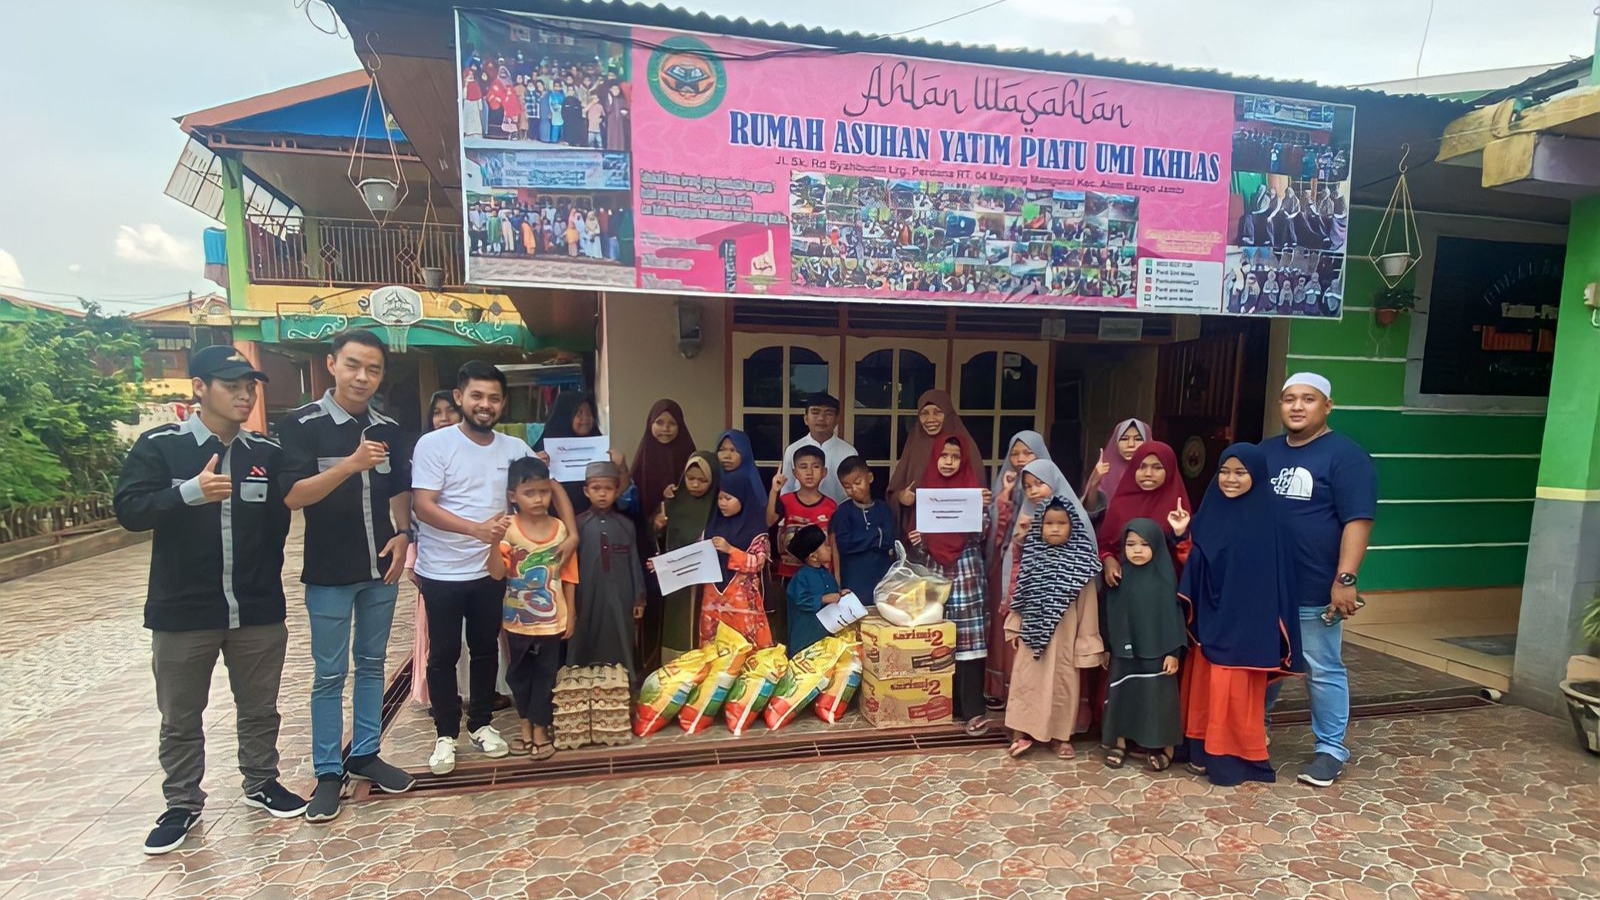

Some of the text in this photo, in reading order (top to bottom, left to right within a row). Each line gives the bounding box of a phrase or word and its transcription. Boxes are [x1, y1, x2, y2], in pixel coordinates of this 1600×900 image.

[729, 110, 1220, 182] RUMAH ASUHAN YATIM PIATU UMI IKHLAS
[931, 630, 943, 646] 2
[928, 679, 940, 695] 2
